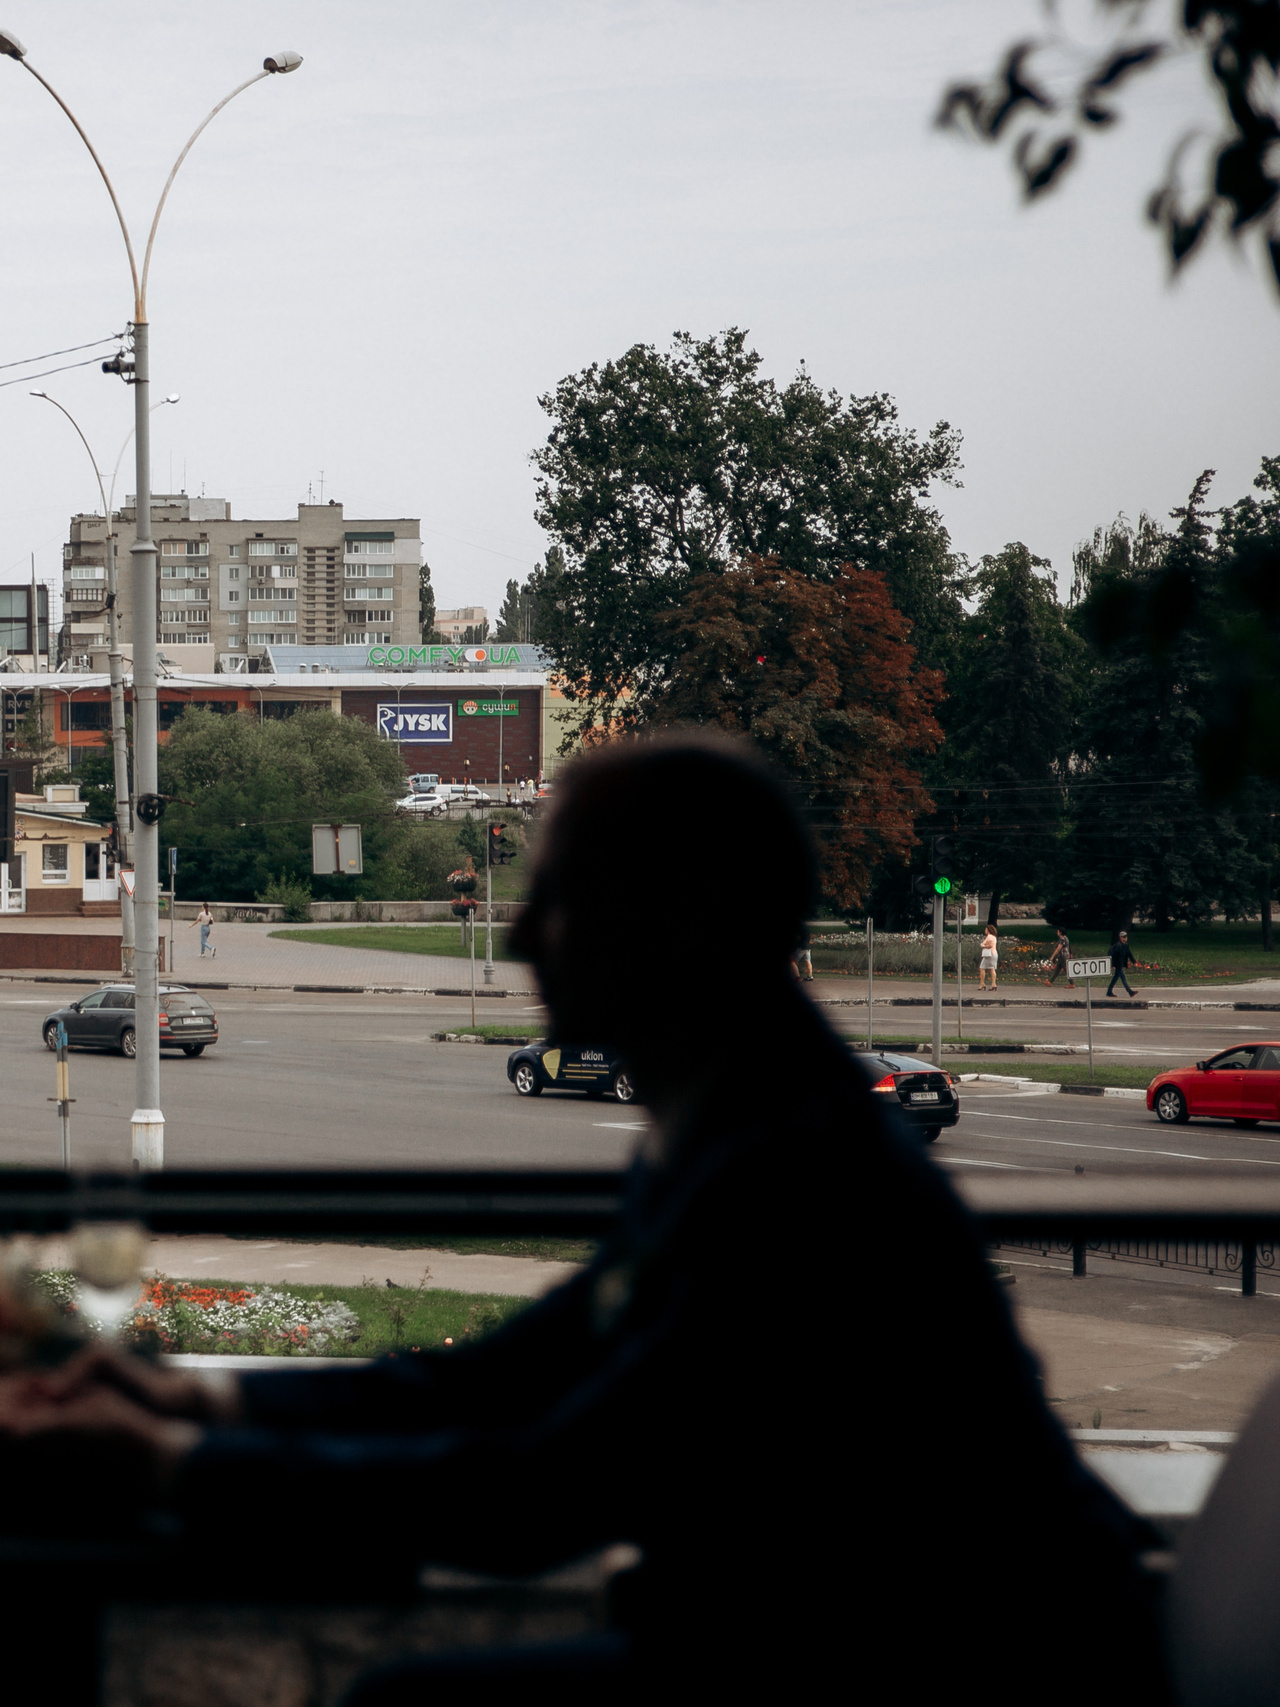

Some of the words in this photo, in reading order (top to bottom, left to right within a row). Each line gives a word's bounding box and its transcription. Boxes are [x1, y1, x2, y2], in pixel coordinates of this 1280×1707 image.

[369, 646, 464, 664] COMFY
[489, 646, 521, 664] UA
[393, 713, 447, 731] JYSK
[1072, 960, 1107, 975] СТОП
[581, 1050, 604, 1061] uklon
